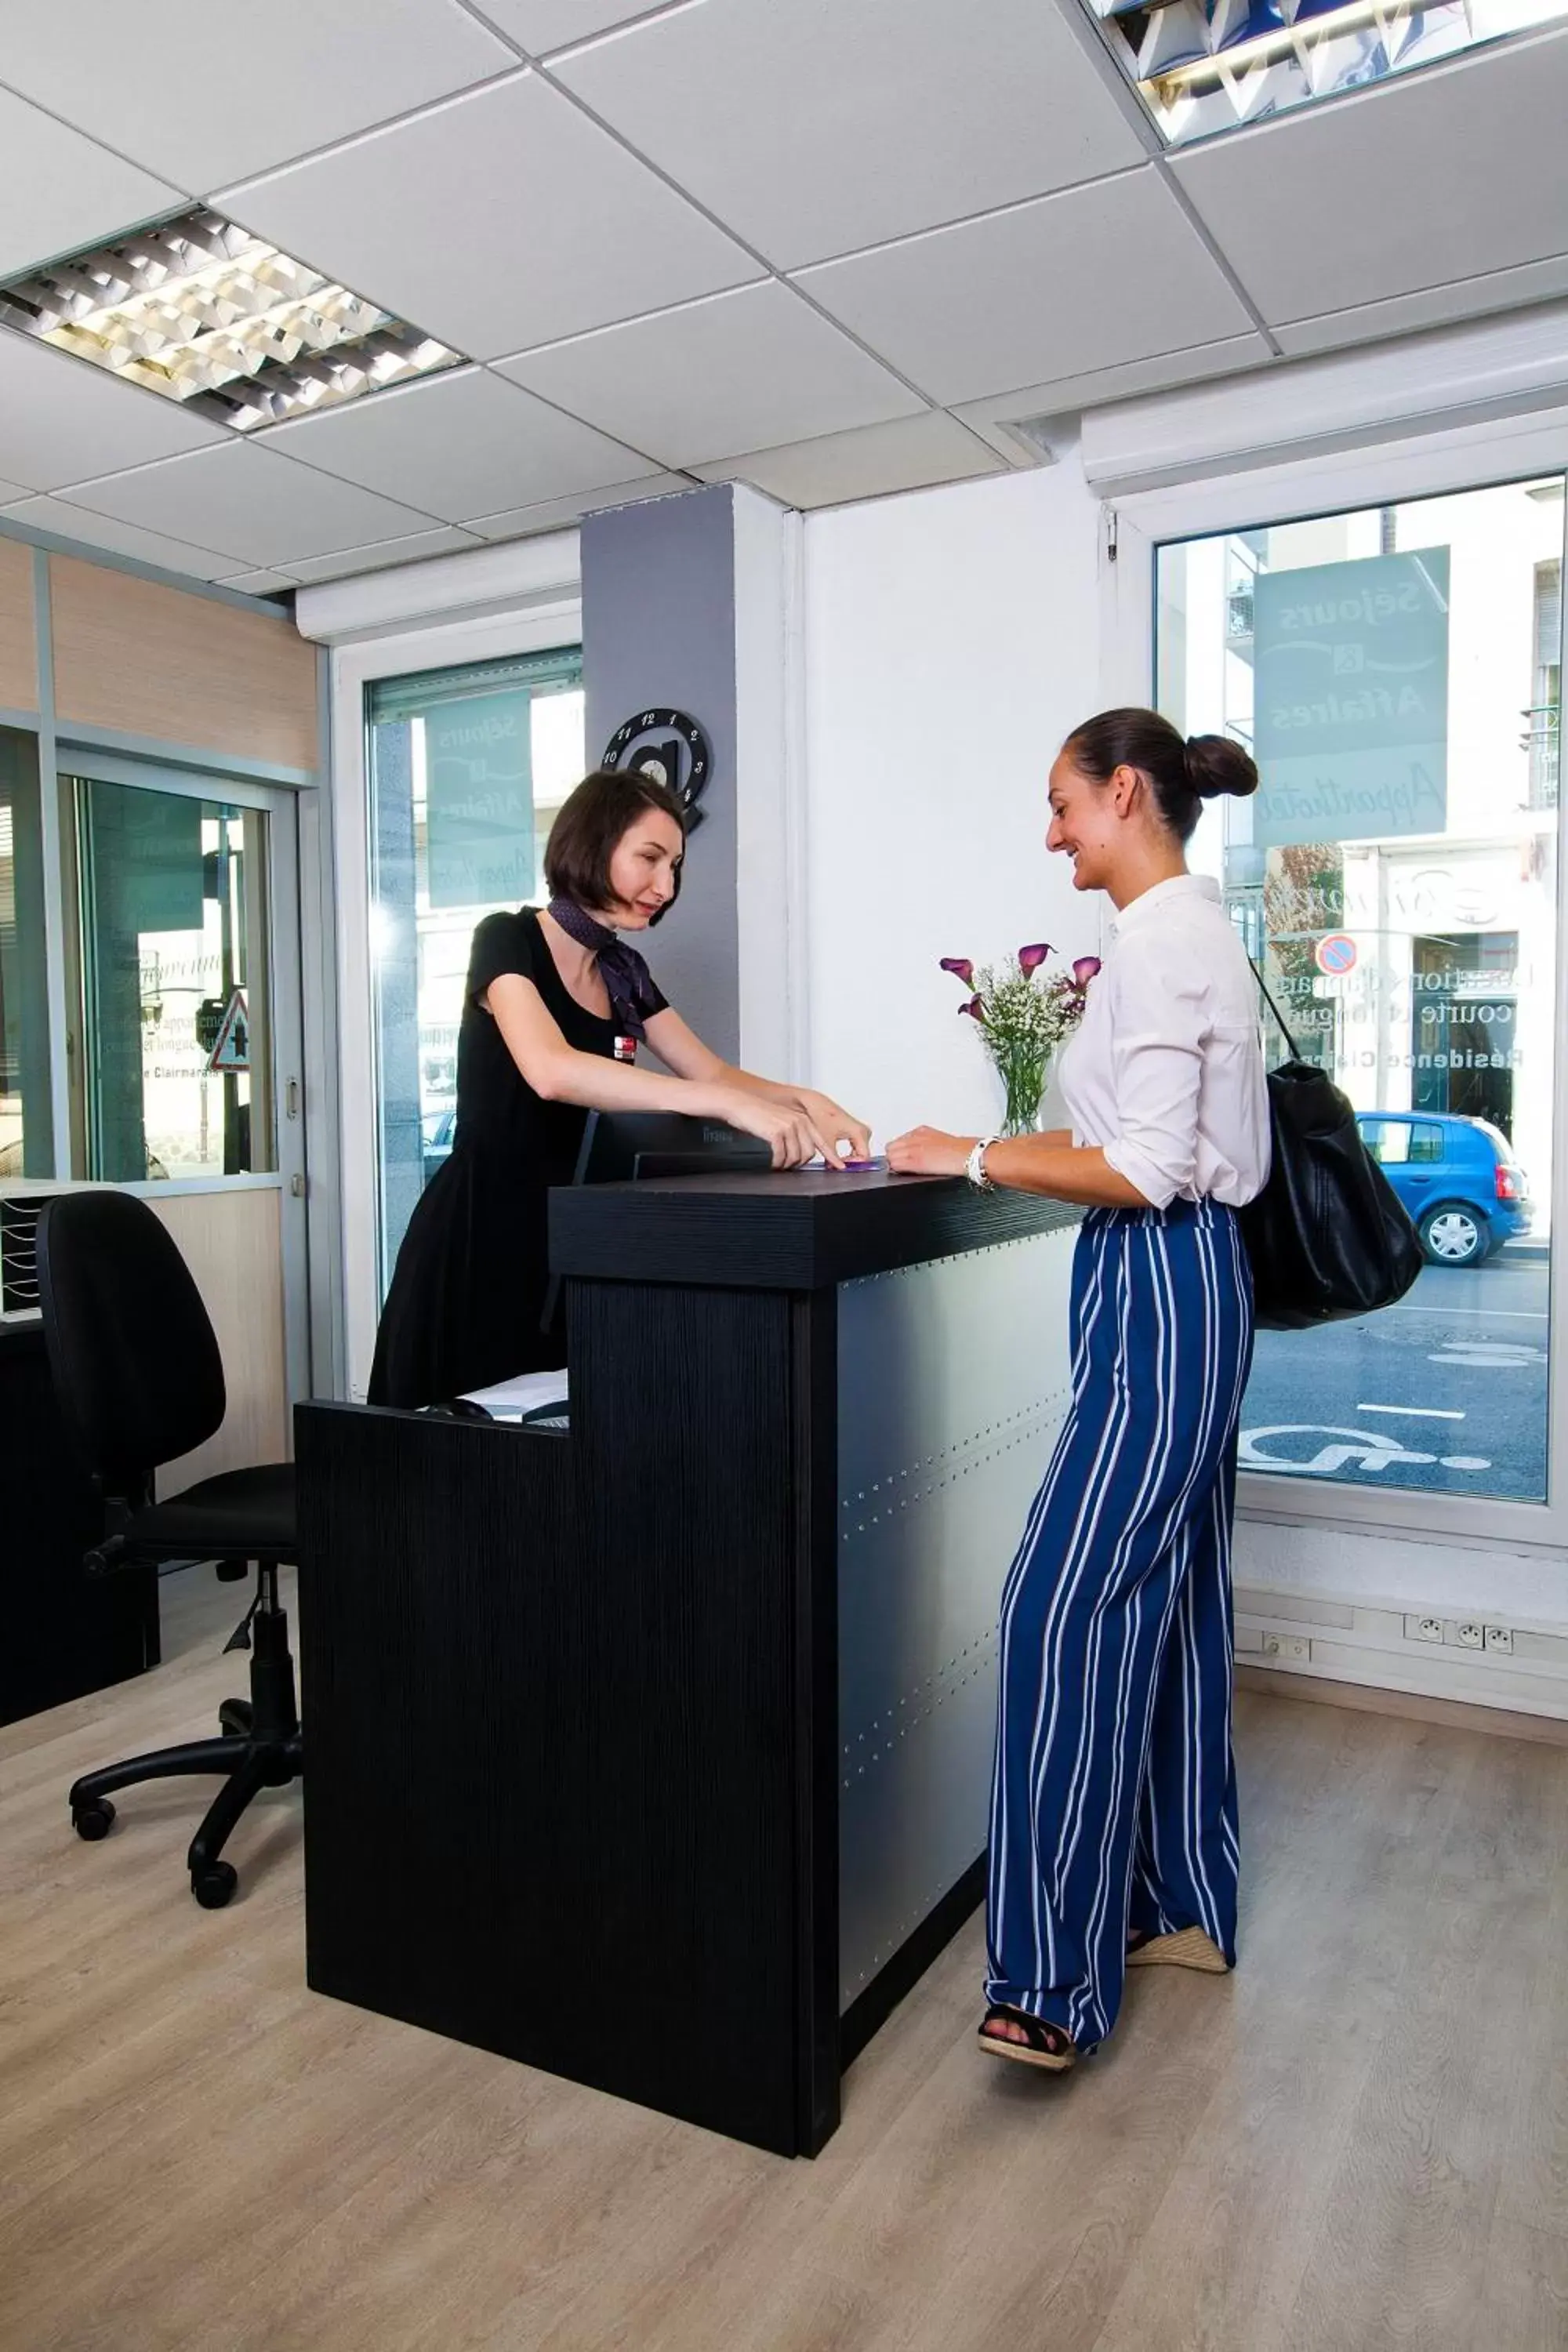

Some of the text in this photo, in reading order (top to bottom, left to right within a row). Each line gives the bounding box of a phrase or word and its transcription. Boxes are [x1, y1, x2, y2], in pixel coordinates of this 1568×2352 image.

[641, 713, 655, 725] 12
[669, 713, 677, 725] 1
[618, 727, 631, 739] 11
[690, 730, 699, 741] 2
[604, 752, 617, 764] 10
[694, 761, 703, 773] 3
